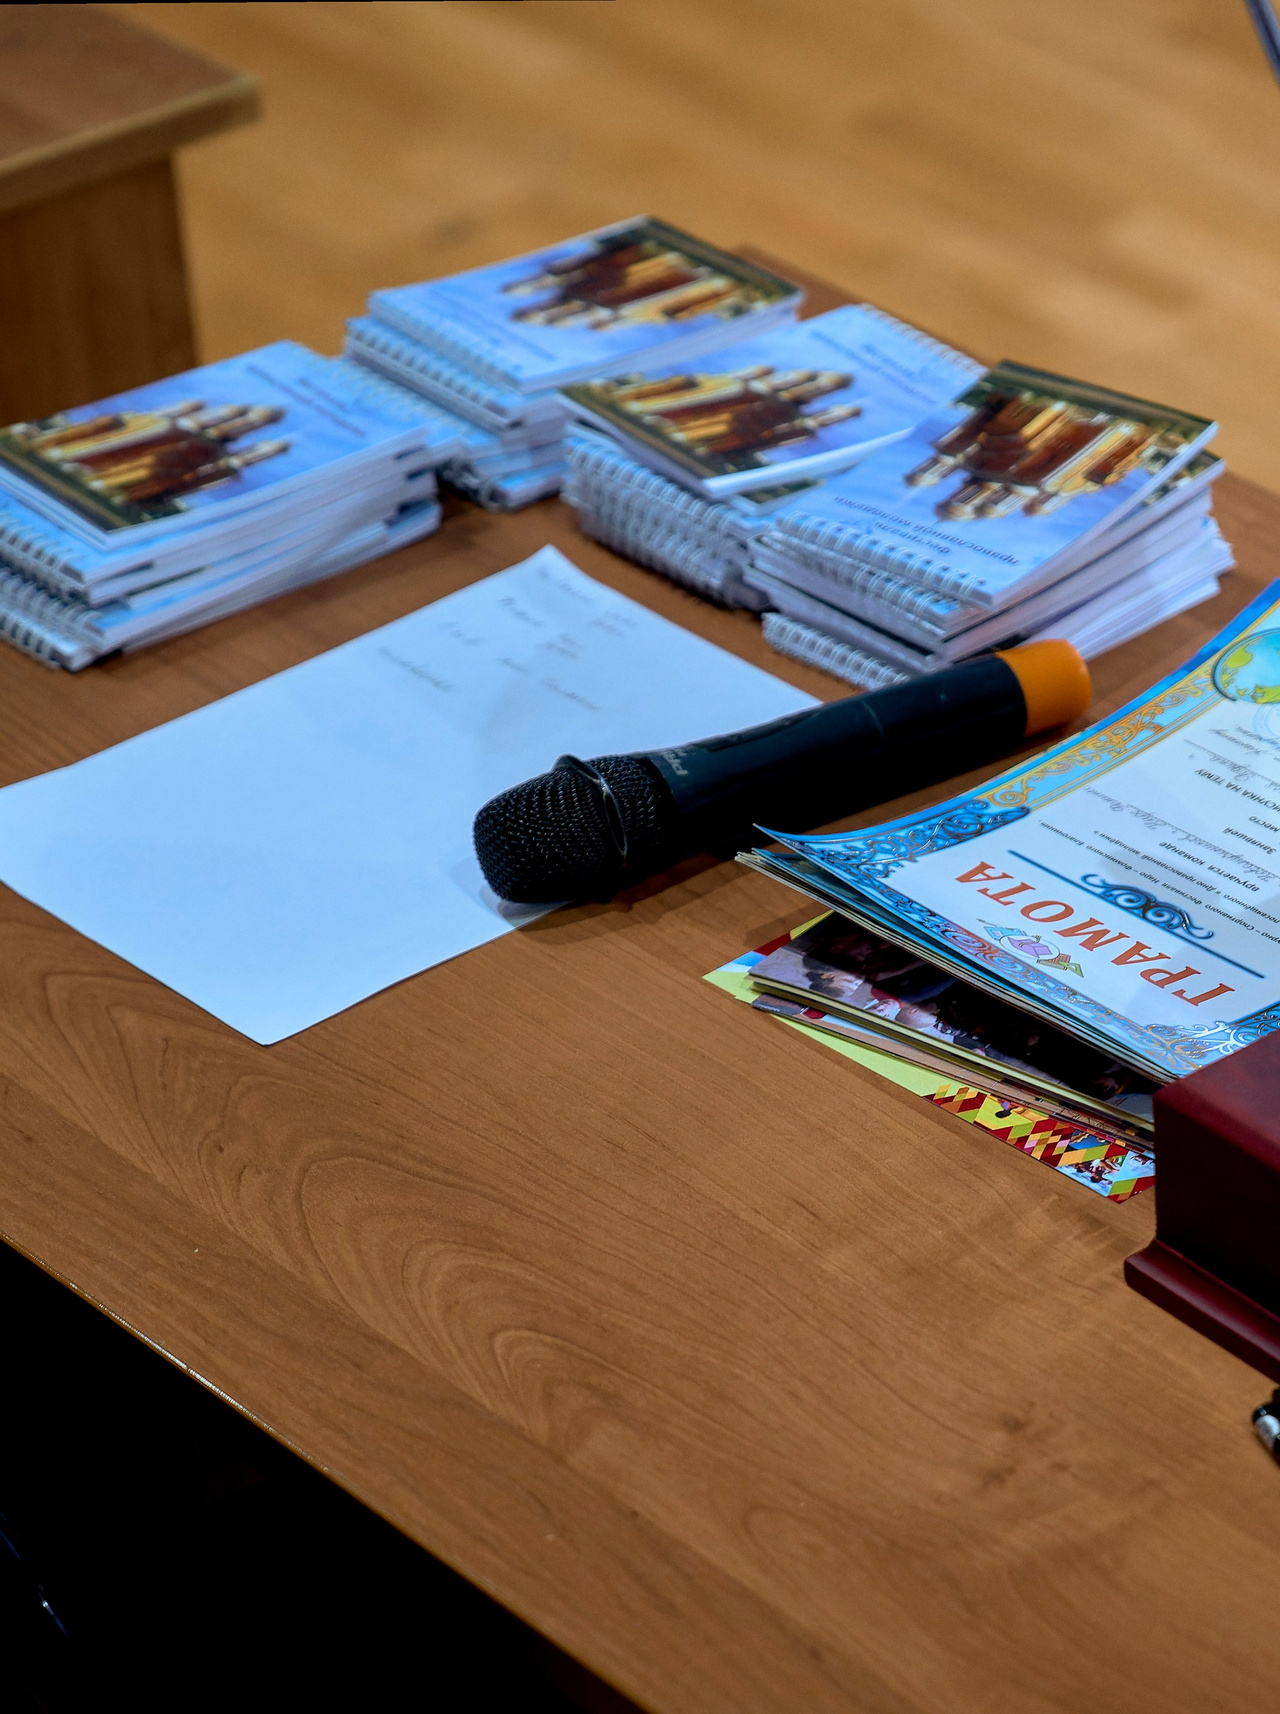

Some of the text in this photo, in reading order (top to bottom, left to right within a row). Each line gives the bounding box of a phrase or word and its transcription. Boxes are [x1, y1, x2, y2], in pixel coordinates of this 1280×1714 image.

[1194, 768, 1227, 784] ТЕМУ
[1222, 781, 1242, 792] НА
[1247, 815, 1280, 832] место
[1221, 826, 1277, 854] Занявшей
[1157, 840, 1261, 891] вручается команде
[1201, 903, 1257, 930] Спортивного
[955, 860, 1235, 1007] ГРАМОТА
